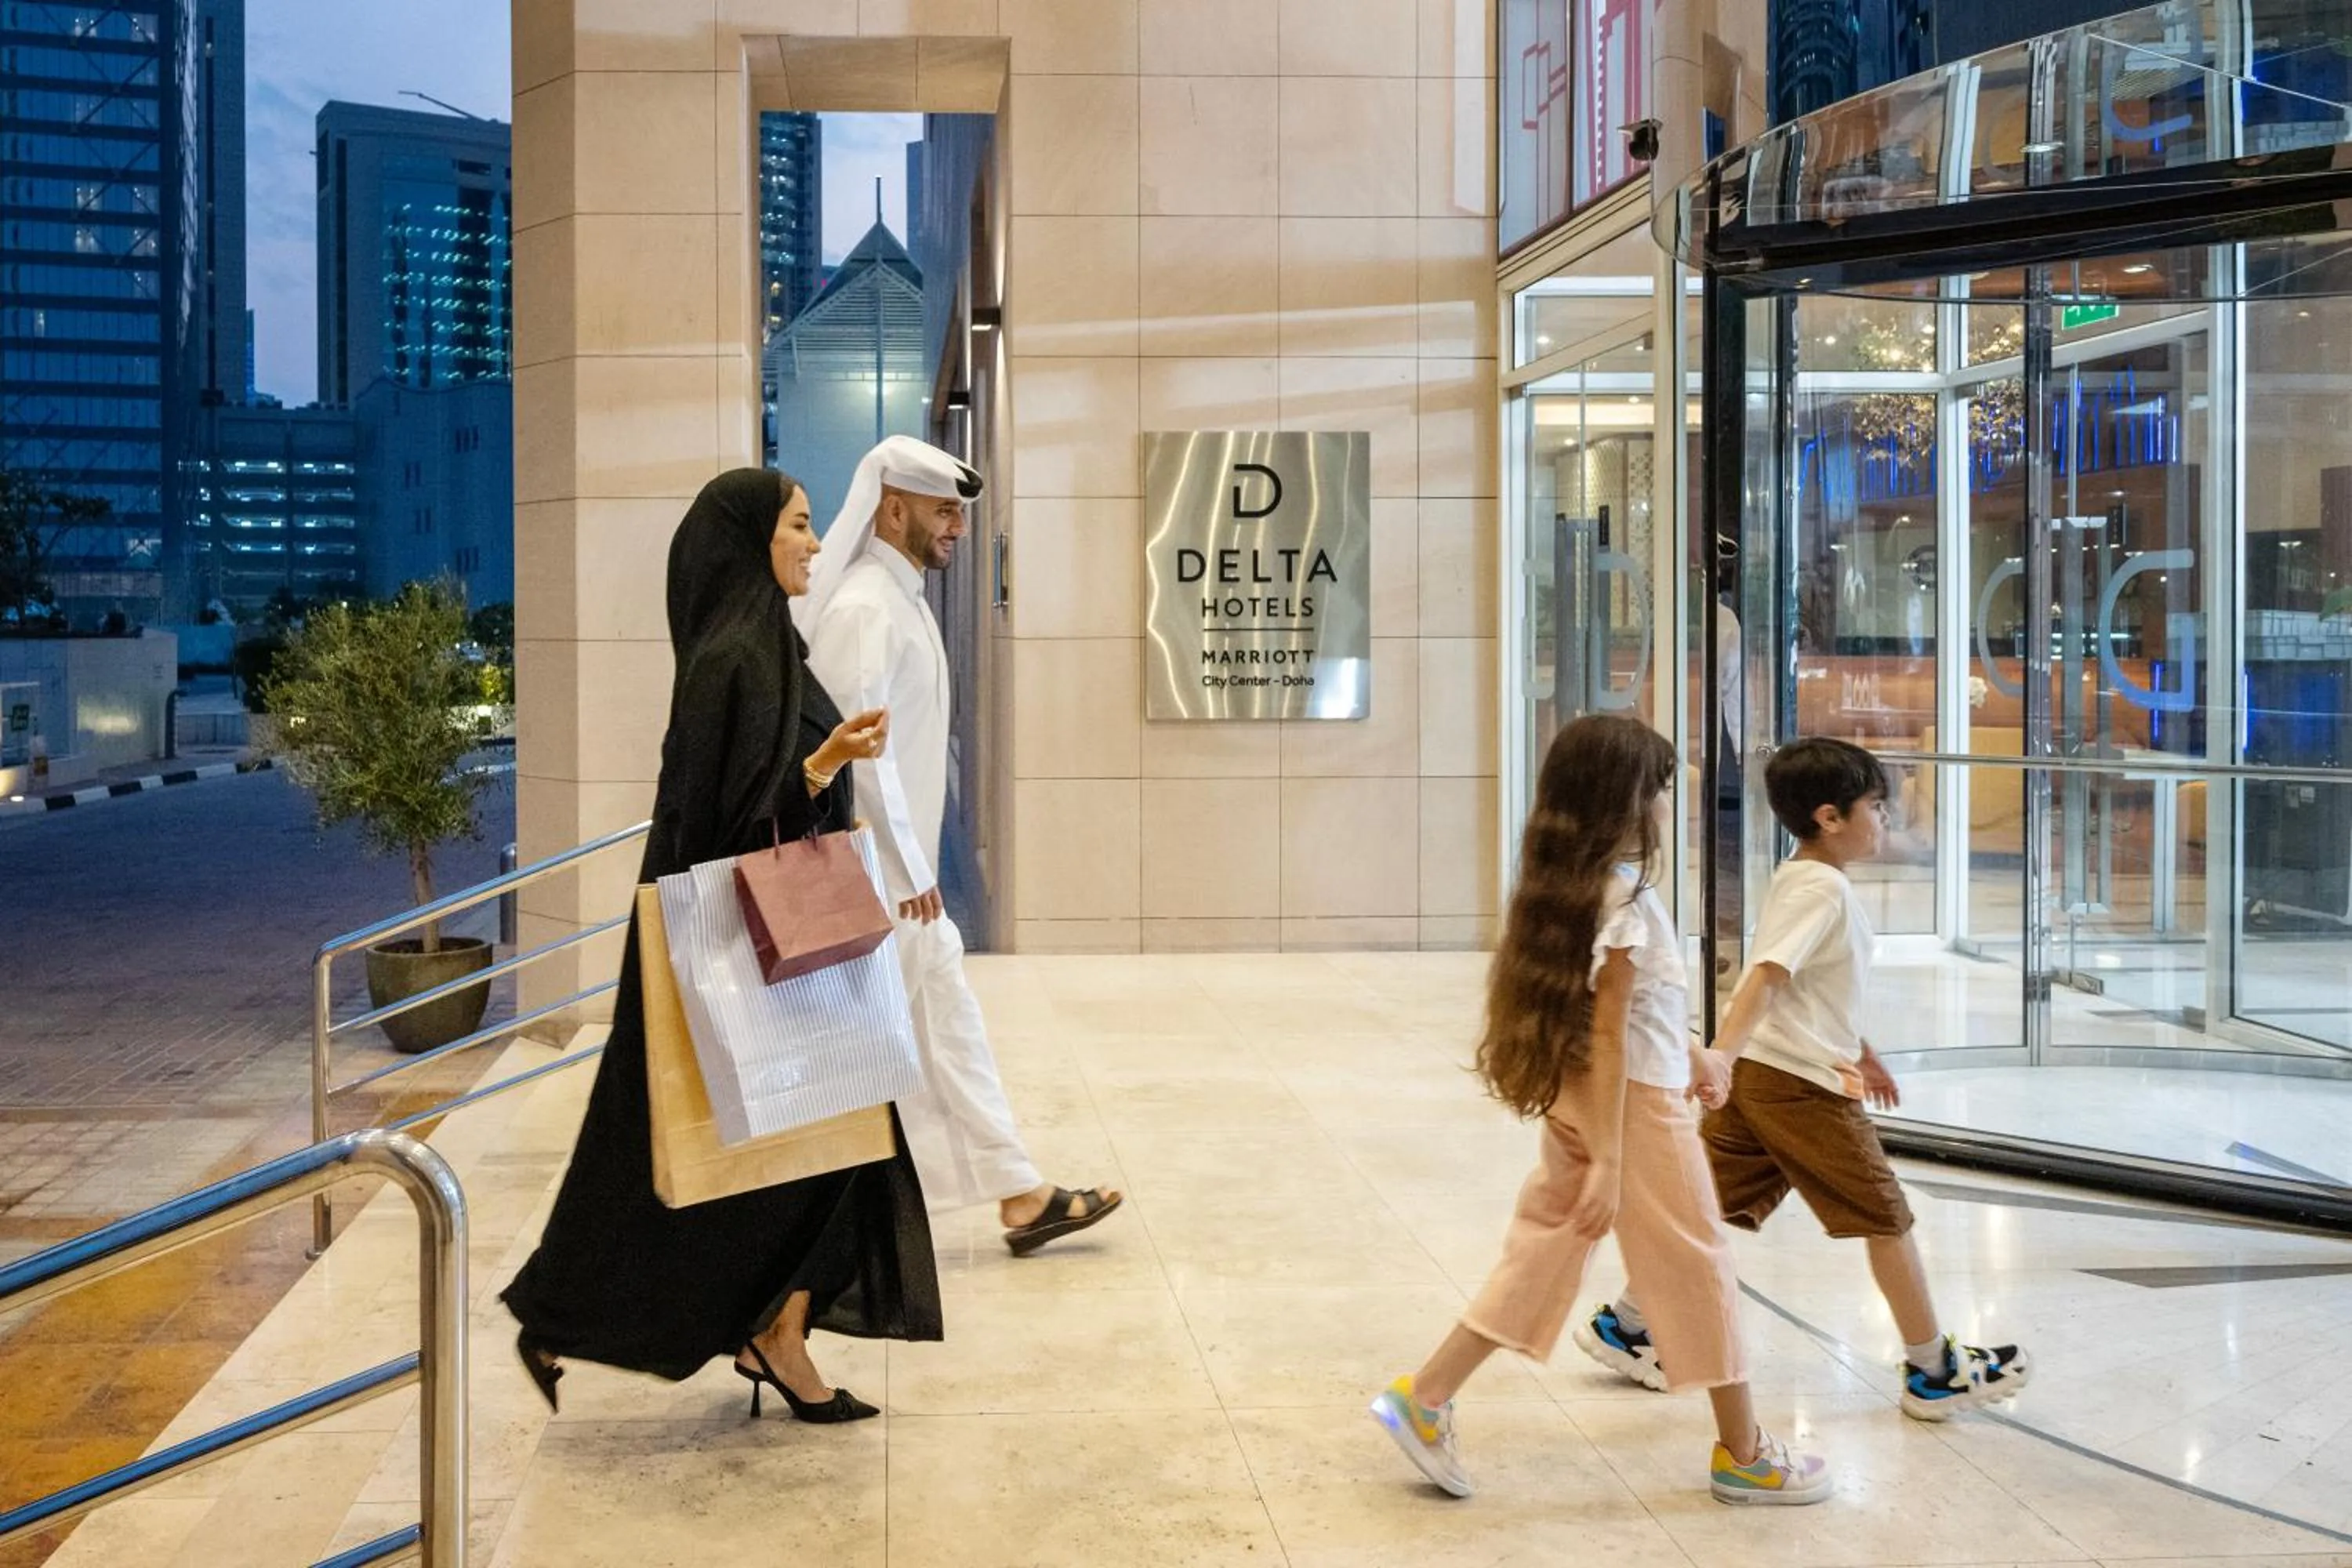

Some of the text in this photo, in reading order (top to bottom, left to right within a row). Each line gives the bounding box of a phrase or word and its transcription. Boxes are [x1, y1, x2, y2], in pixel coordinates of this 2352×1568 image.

[1232, 463, 1283, 518] D
[1177, 549, 1338, 583] DELTA
[1202, 597, 1314, 618] HOTELS
[1202, 650, 1315, 664] MARRIOTT
[1202, 675, 1226, 689] City
[1229, 675, 1271, 687] Center
[1282, 675, 1315, 687] Doha
